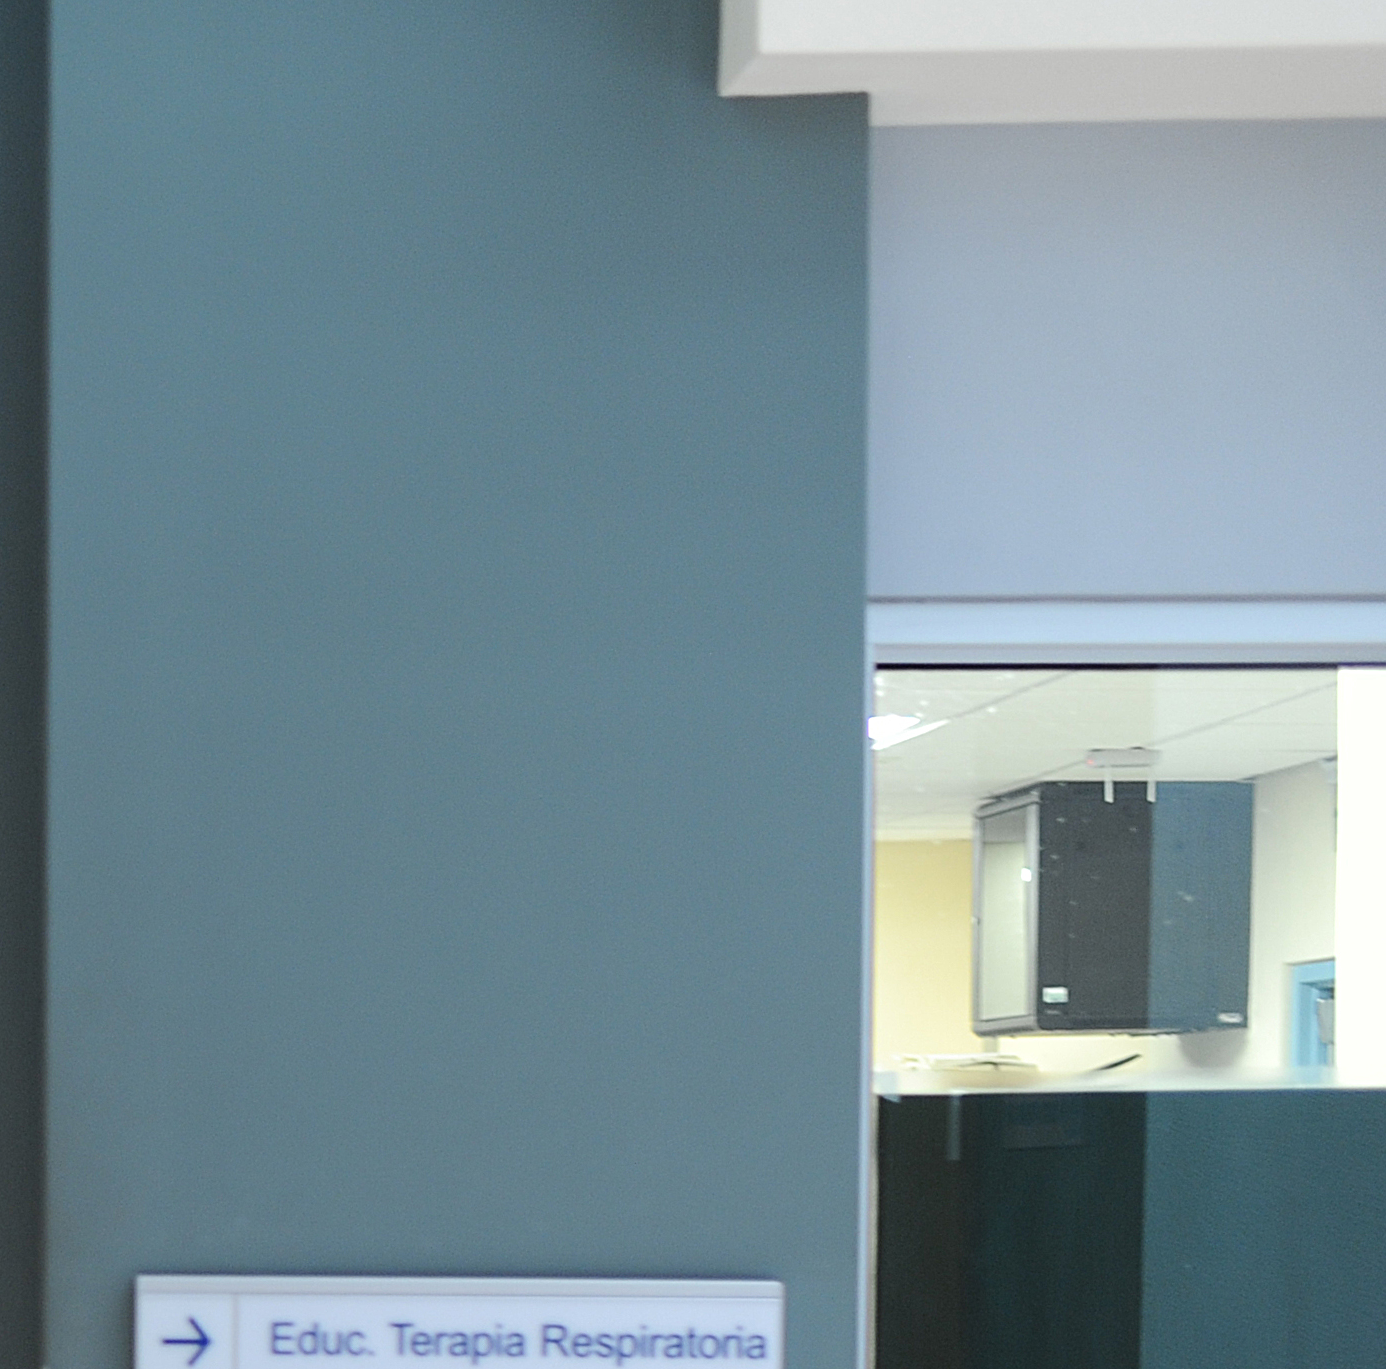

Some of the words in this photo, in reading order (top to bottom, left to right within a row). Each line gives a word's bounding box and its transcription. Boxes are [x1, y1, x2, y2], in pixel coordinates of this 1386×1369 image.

[269, 1321, 375, 1357] Educ.
[389, 1322, 527, 1366] Terapia
[540, 1323, 768, 1367] Respiratoria
